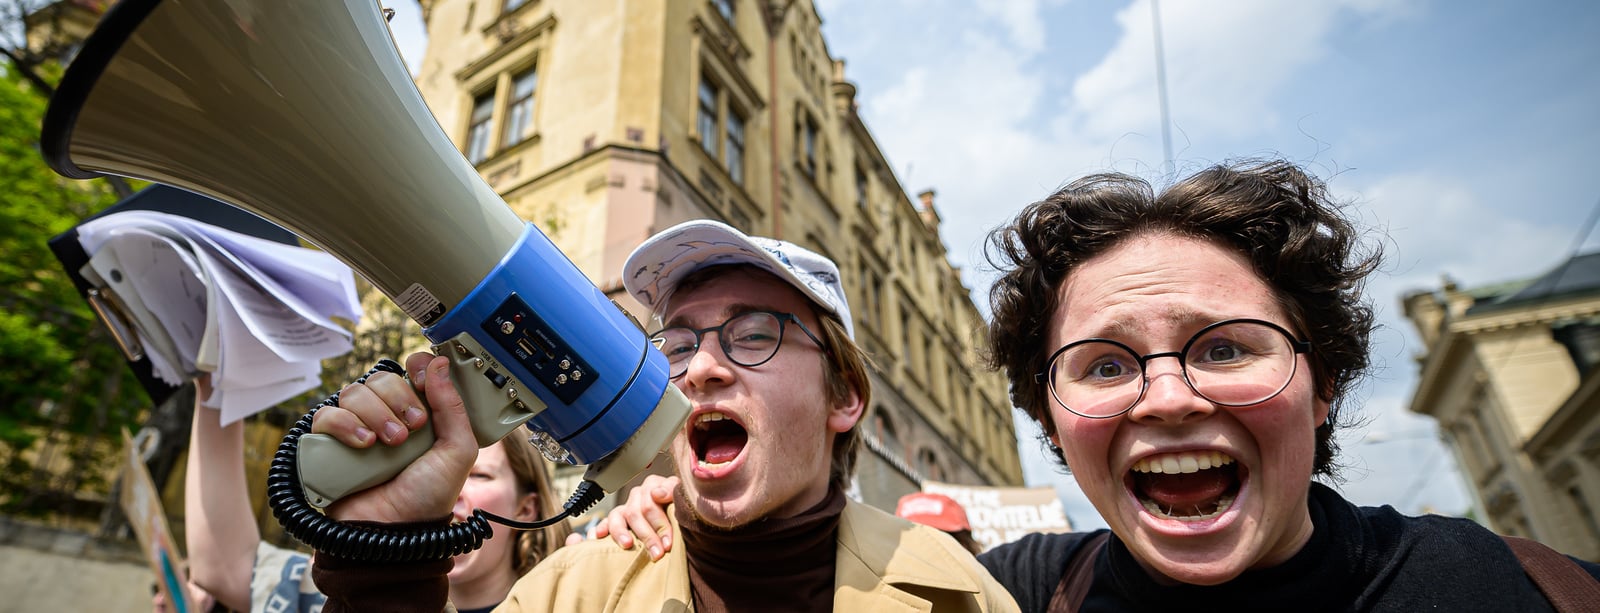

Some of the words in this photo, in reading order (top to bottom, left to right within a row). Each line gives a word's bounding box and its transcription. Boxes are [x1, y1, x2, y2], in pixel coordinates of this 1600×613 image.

[480, 351, 499, 370] USB/SD
[515, 349, 528, 361] USB
[505, 375, 516, 386] MIC
